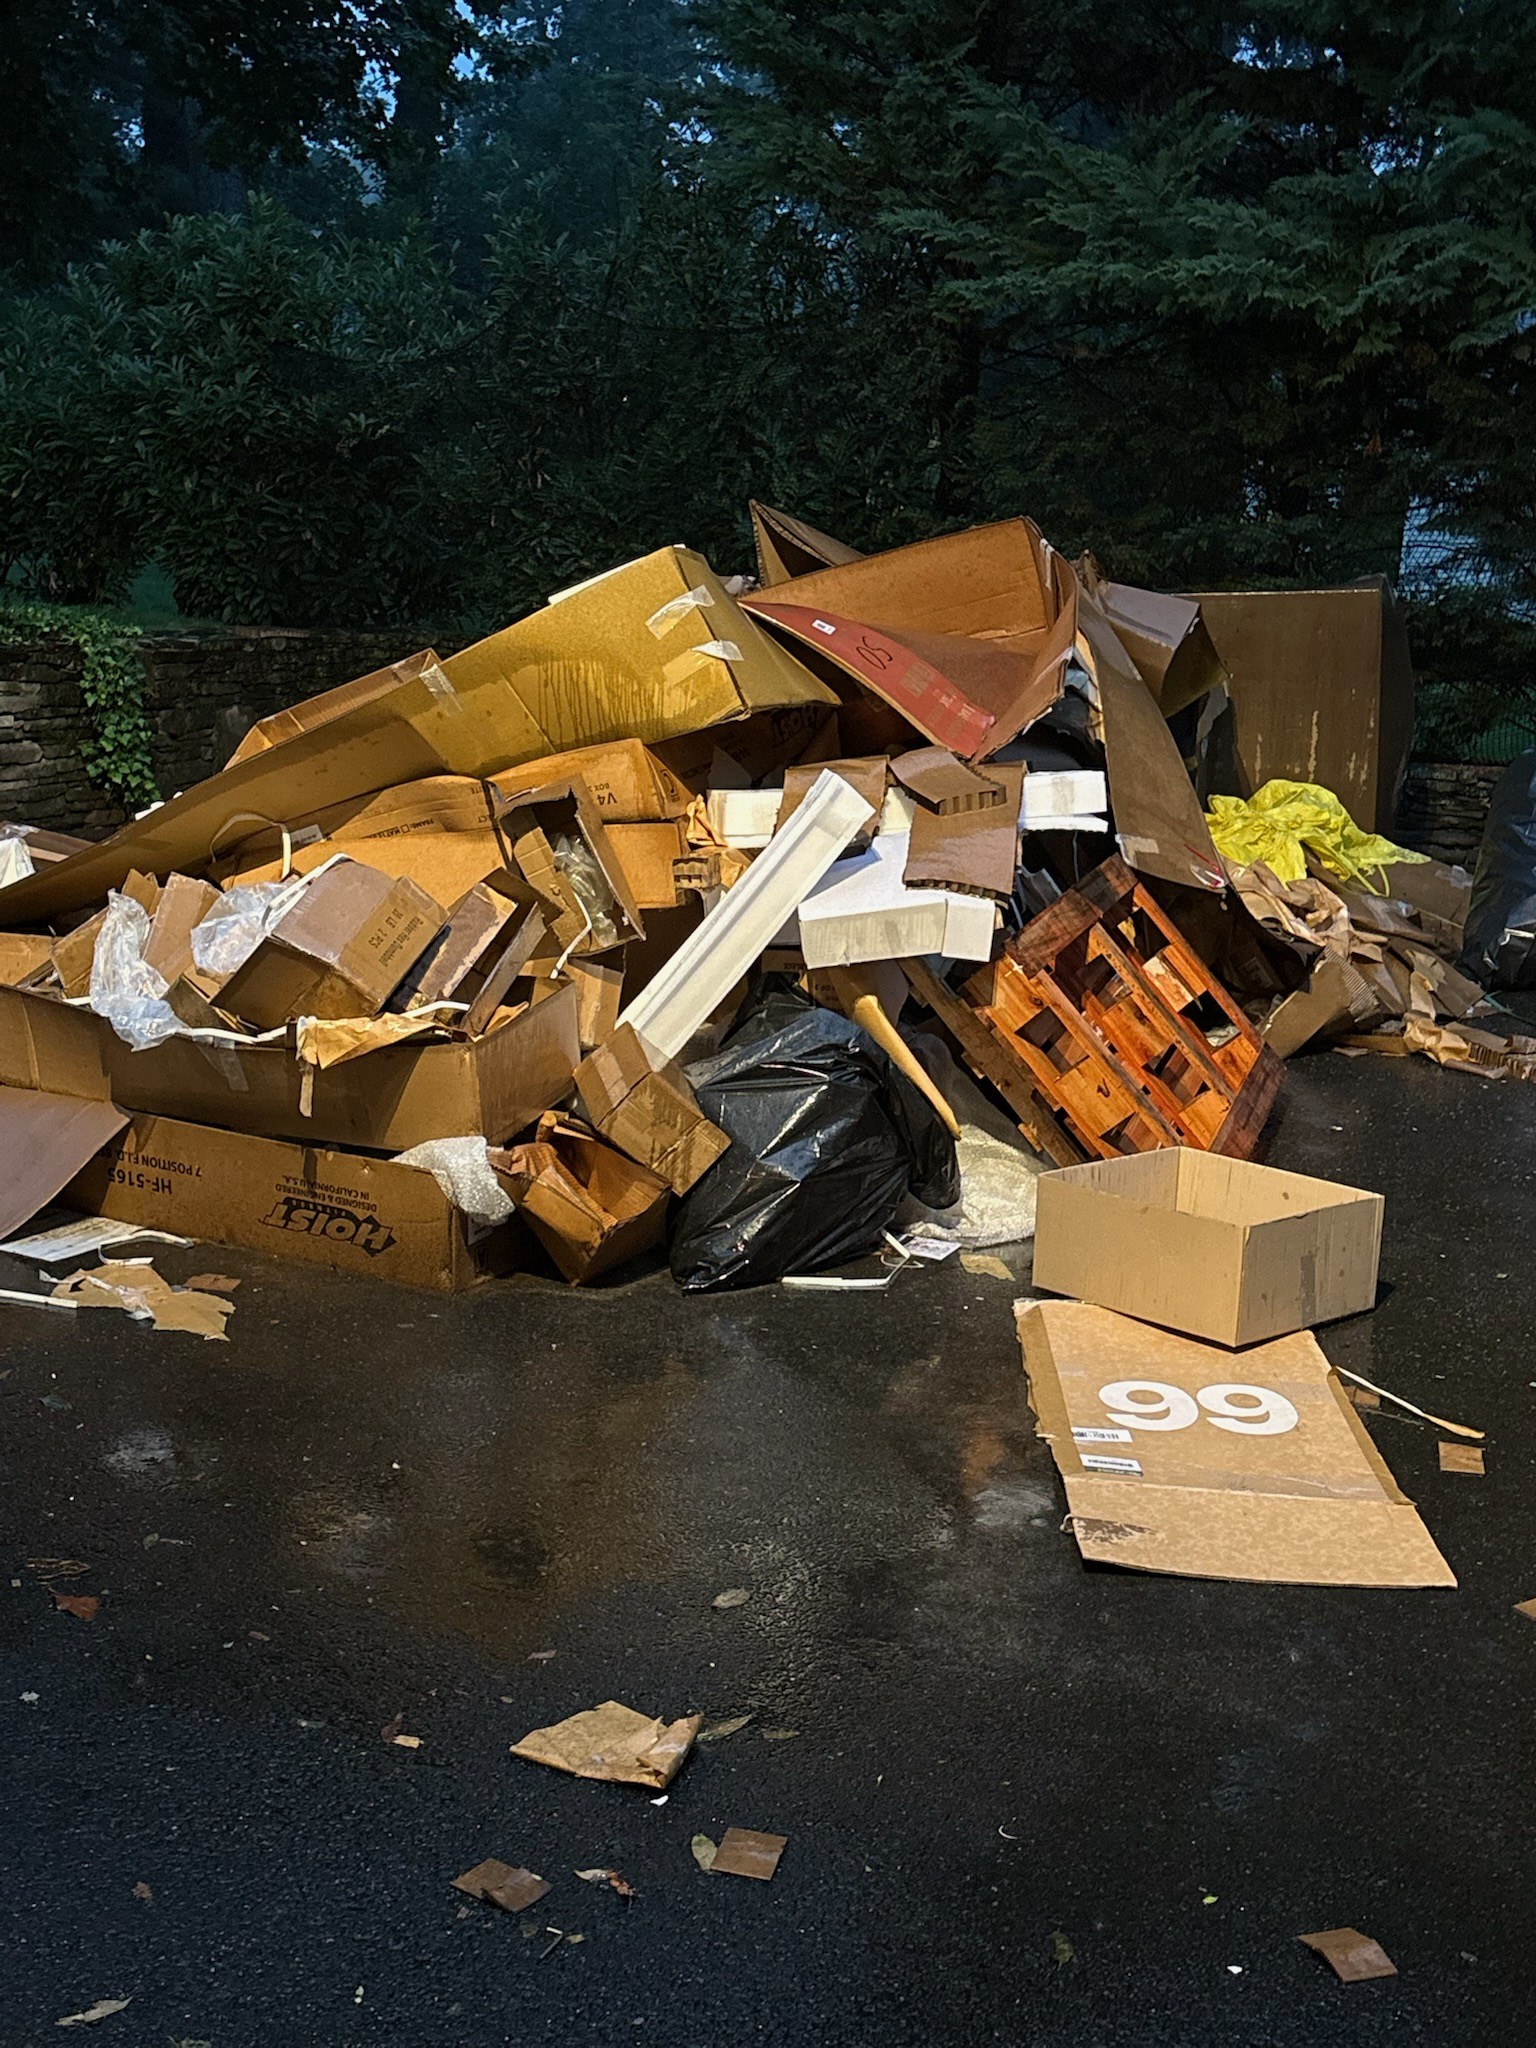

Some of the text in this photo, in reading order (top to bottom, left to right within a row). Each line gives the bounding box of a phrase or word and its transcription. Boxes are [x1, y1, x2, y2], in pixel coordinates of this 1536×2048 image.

[597, 792, 618, 806] V4
[367, 932, 384, 949] PCS
[142, 1154, 193, 1175] POSITION
[195, 1166, 202, 1178] 7
[107, 1168, 172, 1195] HF-5165
[328, 1194, 335, 1202] &
[335, 1196, 377, 1212] DESIGNED
[361, 1191, 369, 1201] IN
[262, 1202, 393, 1250] HOIST
[1098, 1380, 1299, 1436] 99
